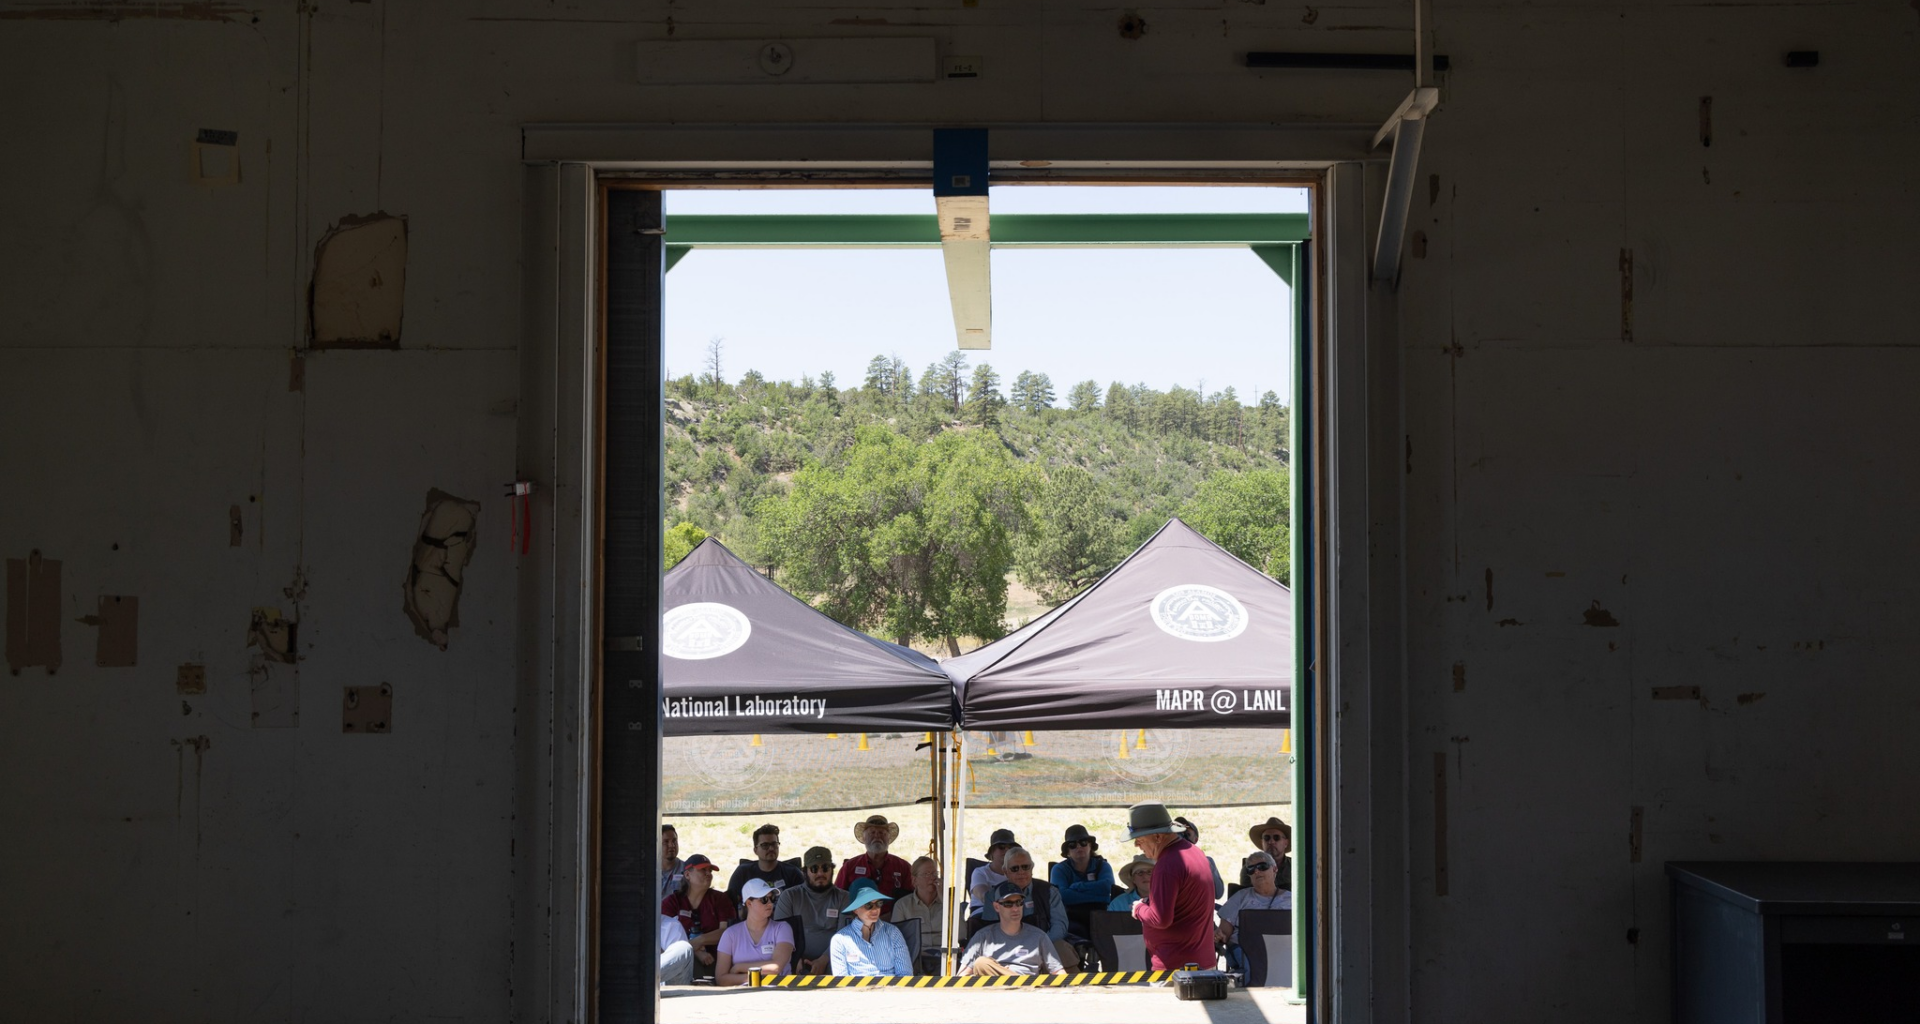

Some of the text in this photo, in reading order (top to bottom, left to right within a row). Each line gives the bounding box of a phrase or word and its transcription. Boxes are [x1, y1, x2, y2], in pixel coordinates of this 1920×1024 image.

[662, 695, 827, 719] National Laboratory
[1156, 689, 1286, 715] MAPR @ LANL
